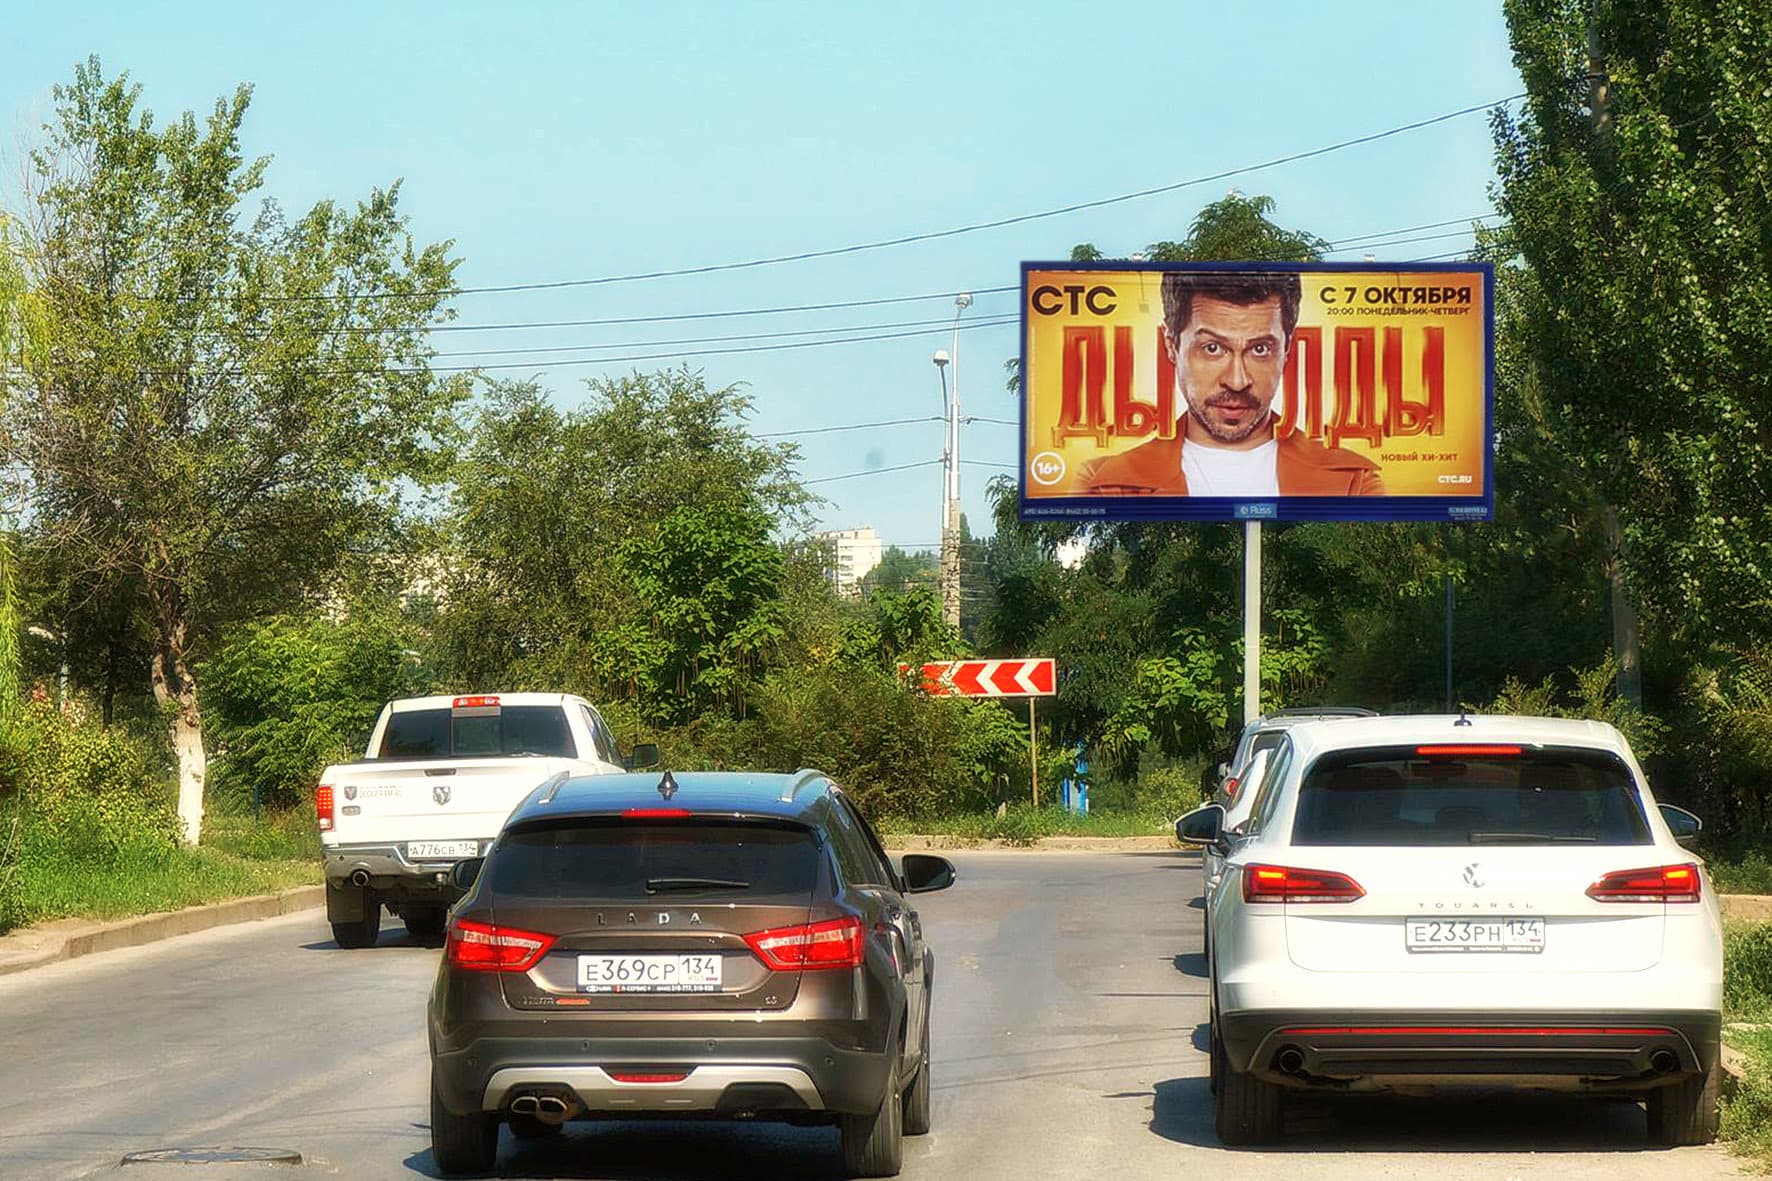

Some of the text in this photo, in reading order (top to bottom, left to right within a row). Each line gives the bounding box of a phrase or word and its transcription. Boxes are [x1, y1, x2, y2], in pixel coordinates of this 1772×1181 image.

[1032, 285, 1117, 315] СТС
[1320, 287, 1471, 304] С 7 ОКТЯБРЯ
[1327, 307, 1471, 317] 20:00 ПОНЕДЕЛЬНИК-ЧЕТВЕРГ
[1381, 452, 1458, 462] НОВЫЙ ХИ-ХИТ
[1037, 462, 1061, 475] 16+
[597, 911, 703, 926] LADA
[1506, 919, 1538, 937] 134
[681, 957, 715, 975] 134
